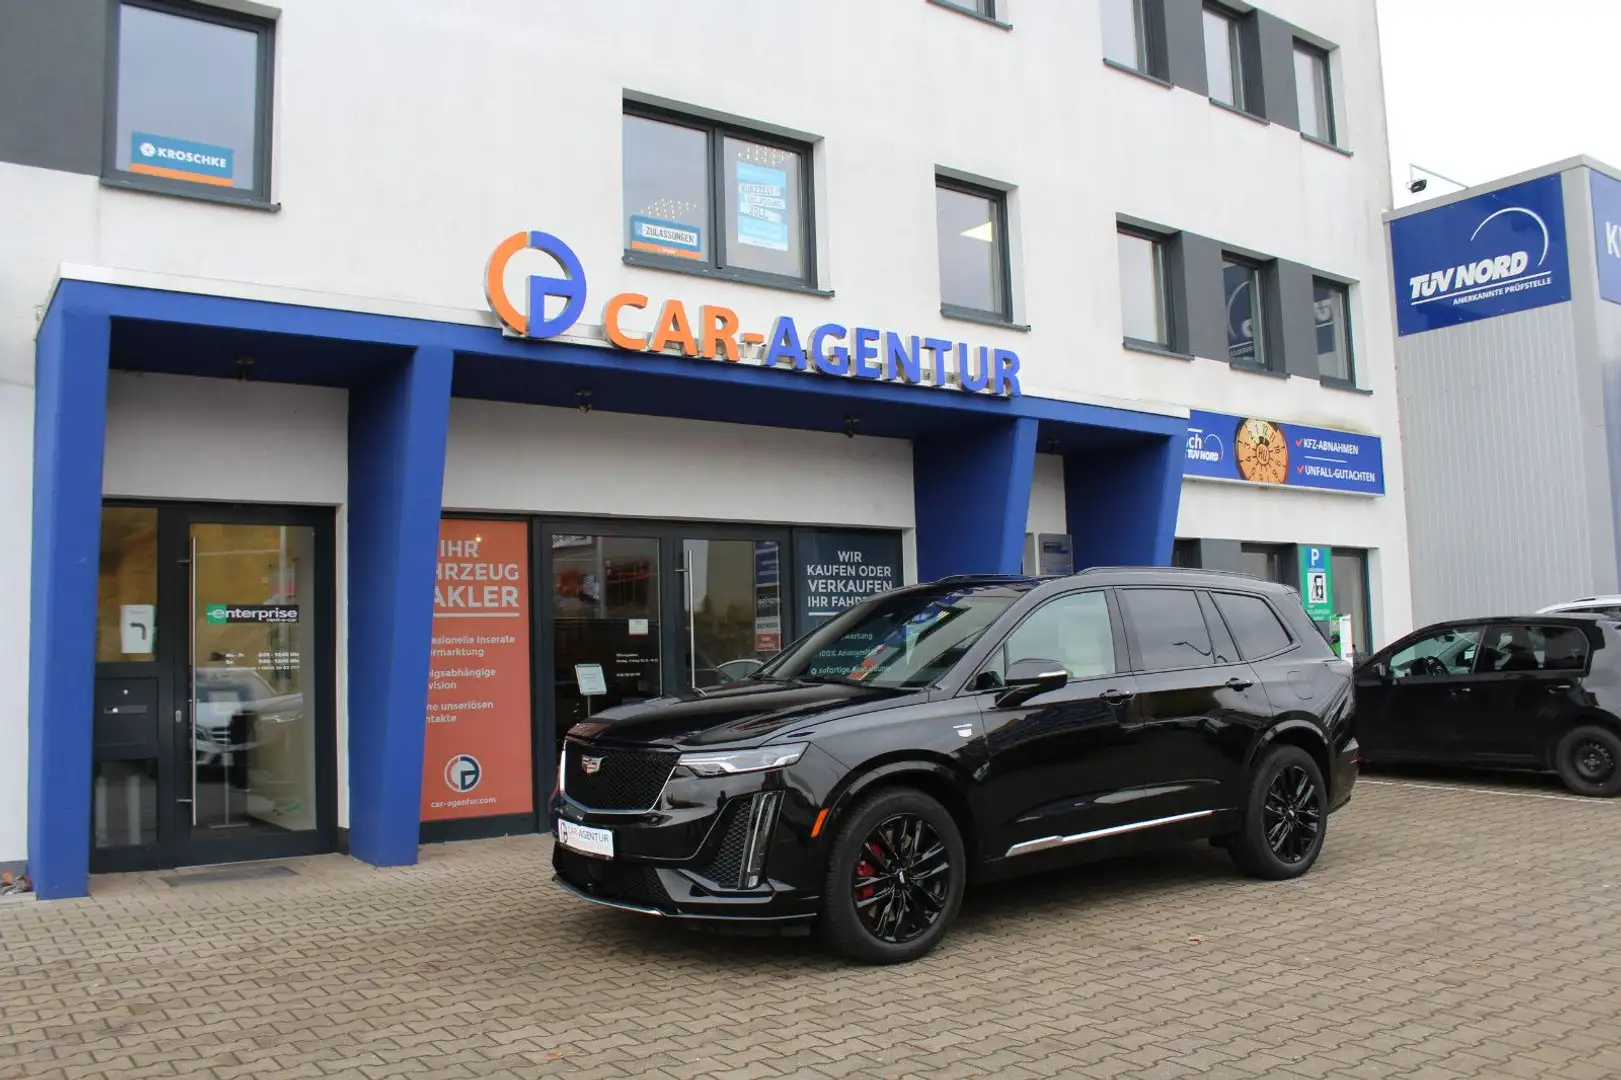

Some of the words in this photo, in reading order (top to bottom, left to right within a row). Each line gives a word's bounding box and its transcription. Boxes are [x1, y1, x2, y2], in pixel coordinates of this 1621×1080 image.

[156, 147, 226, 168] KROSCHKE
[645, 226, 695, 243] ZULASSUNGEN
[1605, 221, 1621, 257] K
[1409, 267, 1454, 299] TÜV
[1455, 251, 1528, 289] NORD
[1453, 288, 1503, 305] ANERKANNTE
[1505, 276, 1552, 294] PRÜFSTELLE
[603, 292, 1021, 397] CAR-AGENTUR
[1303, 438, 1359, 455] KFZ-ABNAHMEN
[1200, 450, 1219, 461] NORD
[1258, 447, 1268, 462] HU
[1304, 465, 1376, 482] UNFALL-GUTACHTEN
[440, 540, 479, 557] IHR
[837, 550, 862, 562] WIR
[1311, 548, 1320, 566] P
[807, 565, 855, 576] KAUFEN
[860, 566, 892, 577] ODER
[808, 580, 893, 592] VERKAUFEN
[808, 597, 828, 607] IHR
[207, 608, 298, 621] enterprise
[477, 634, 515, 644] Inserate
[429, 667, 497, 679] lgsabhängige
[819, 665, 850, 676] sofortige
[441, 701, 494, 710] unseriösen
[431, 797, 497, 808] car-agentur.com
[579, 829, 609, 843] AGENTUR
